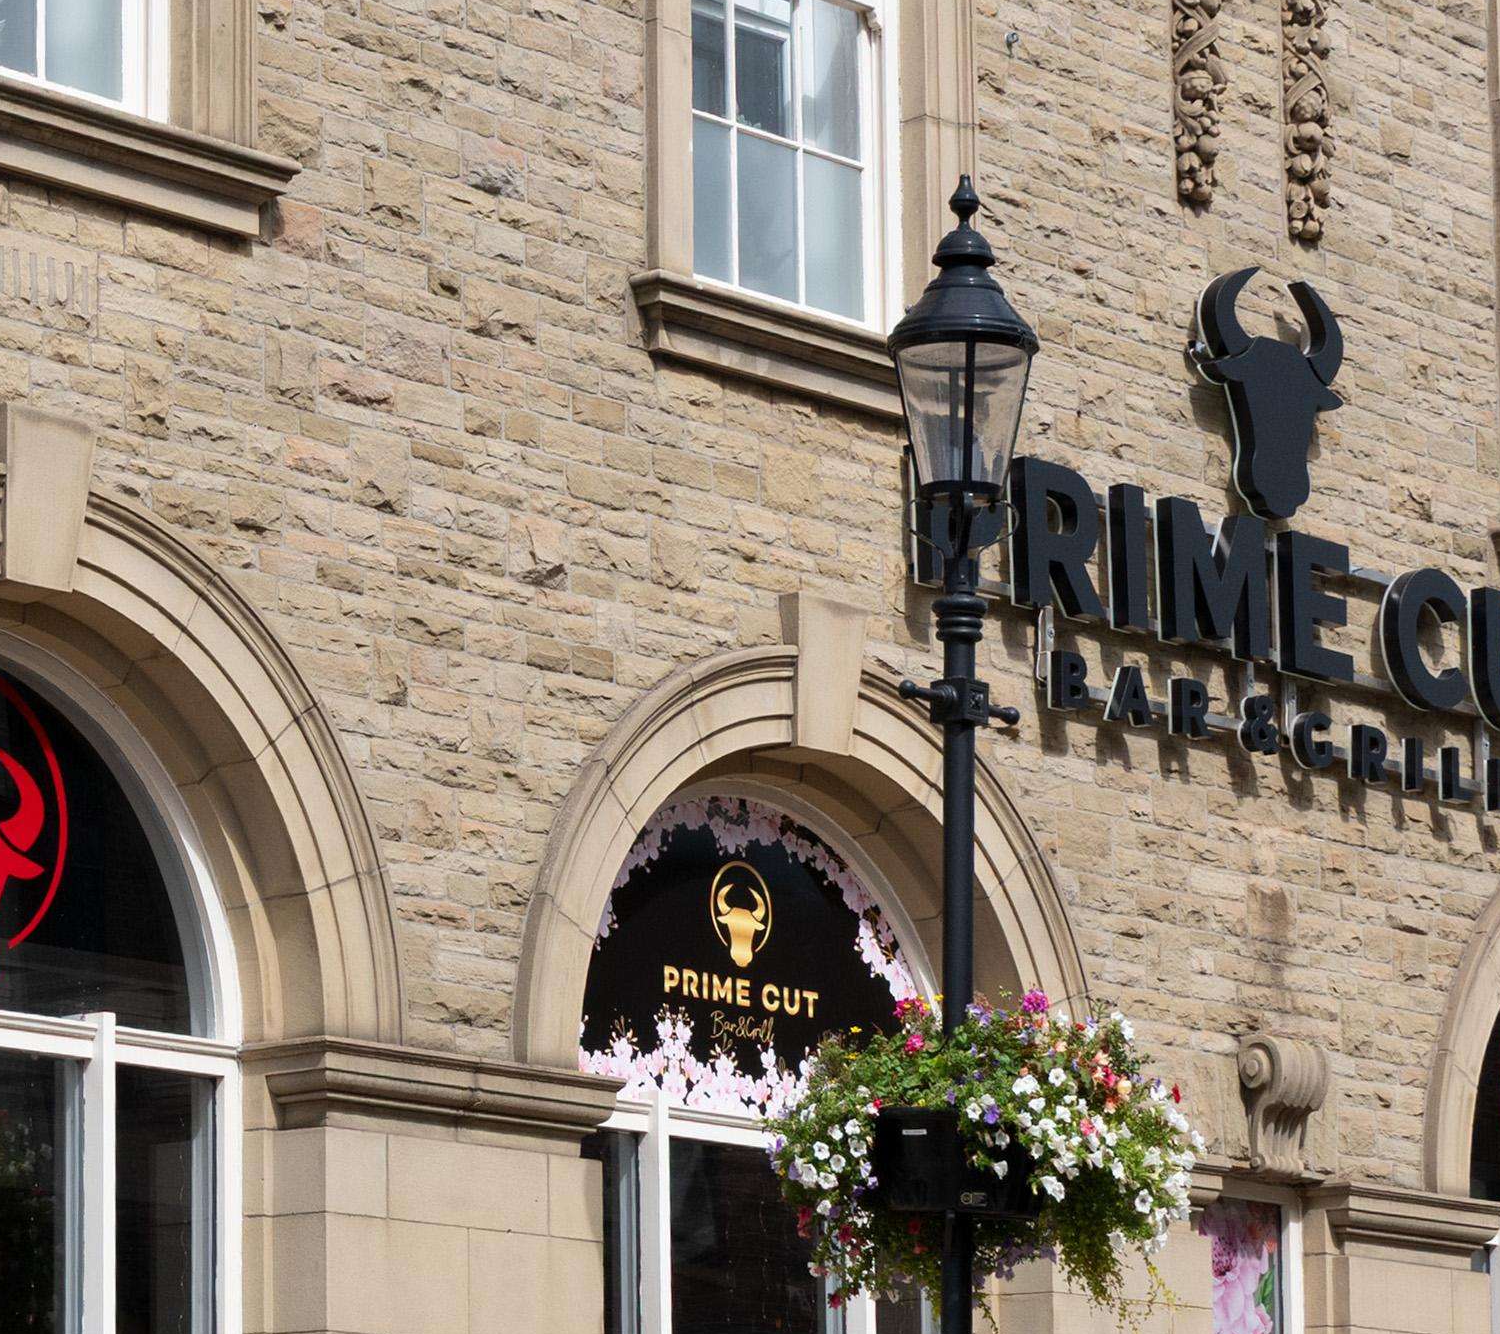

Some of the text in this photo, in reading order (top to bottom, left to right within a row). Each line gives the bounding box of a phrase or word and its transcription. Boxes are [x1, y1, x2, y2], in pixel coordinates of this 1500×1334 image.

[1047, 650, 1213, 739] BAR
[1237, 696, 1280, 756] &
[663, 965, 819, 1019] PRIME CUT
